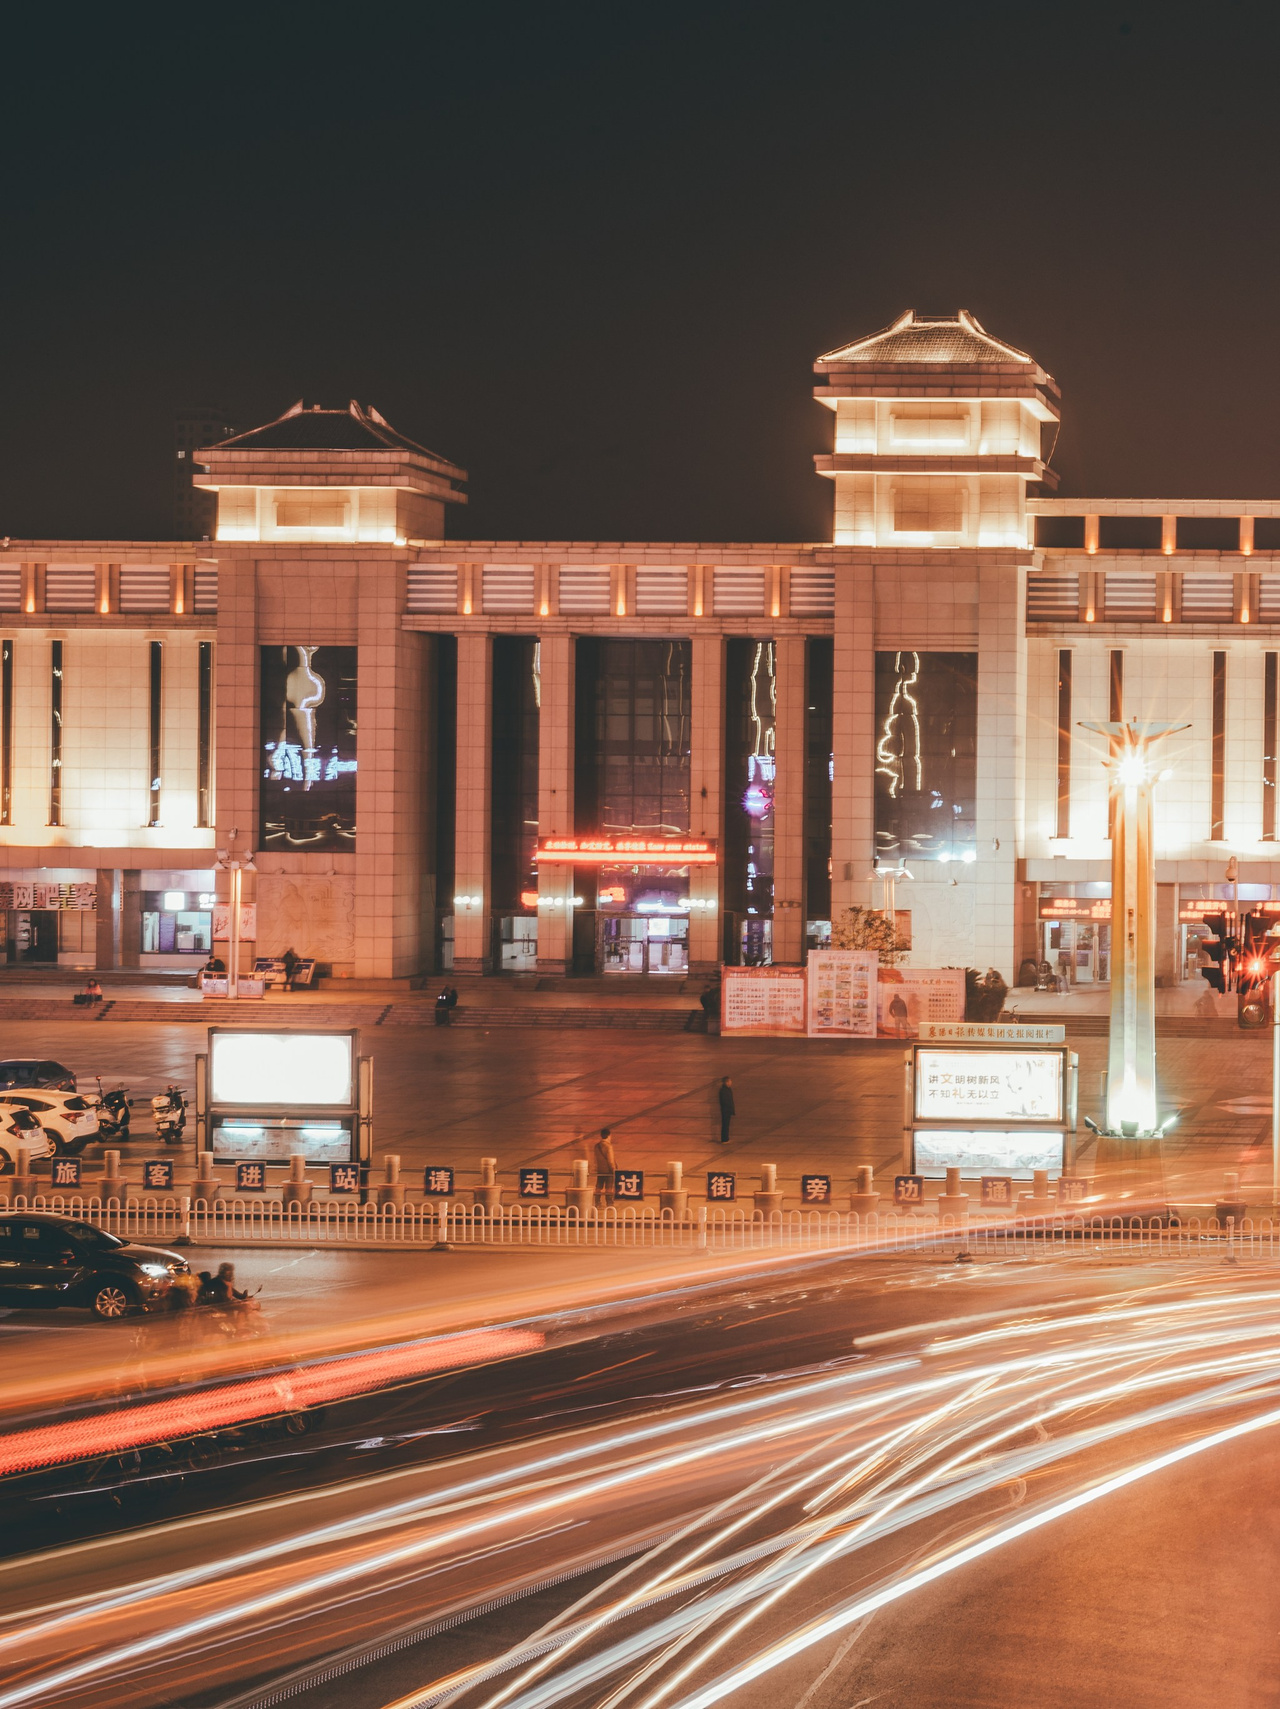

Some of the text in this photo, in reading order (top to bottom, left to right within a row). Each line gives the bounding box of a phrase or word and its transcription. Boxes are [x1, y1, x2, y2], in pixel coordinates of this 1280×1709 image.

[928, 1072, 1000, 1085] 讲文明树新风
[928, 1088, 1000, 1100] 不知礼无以立
